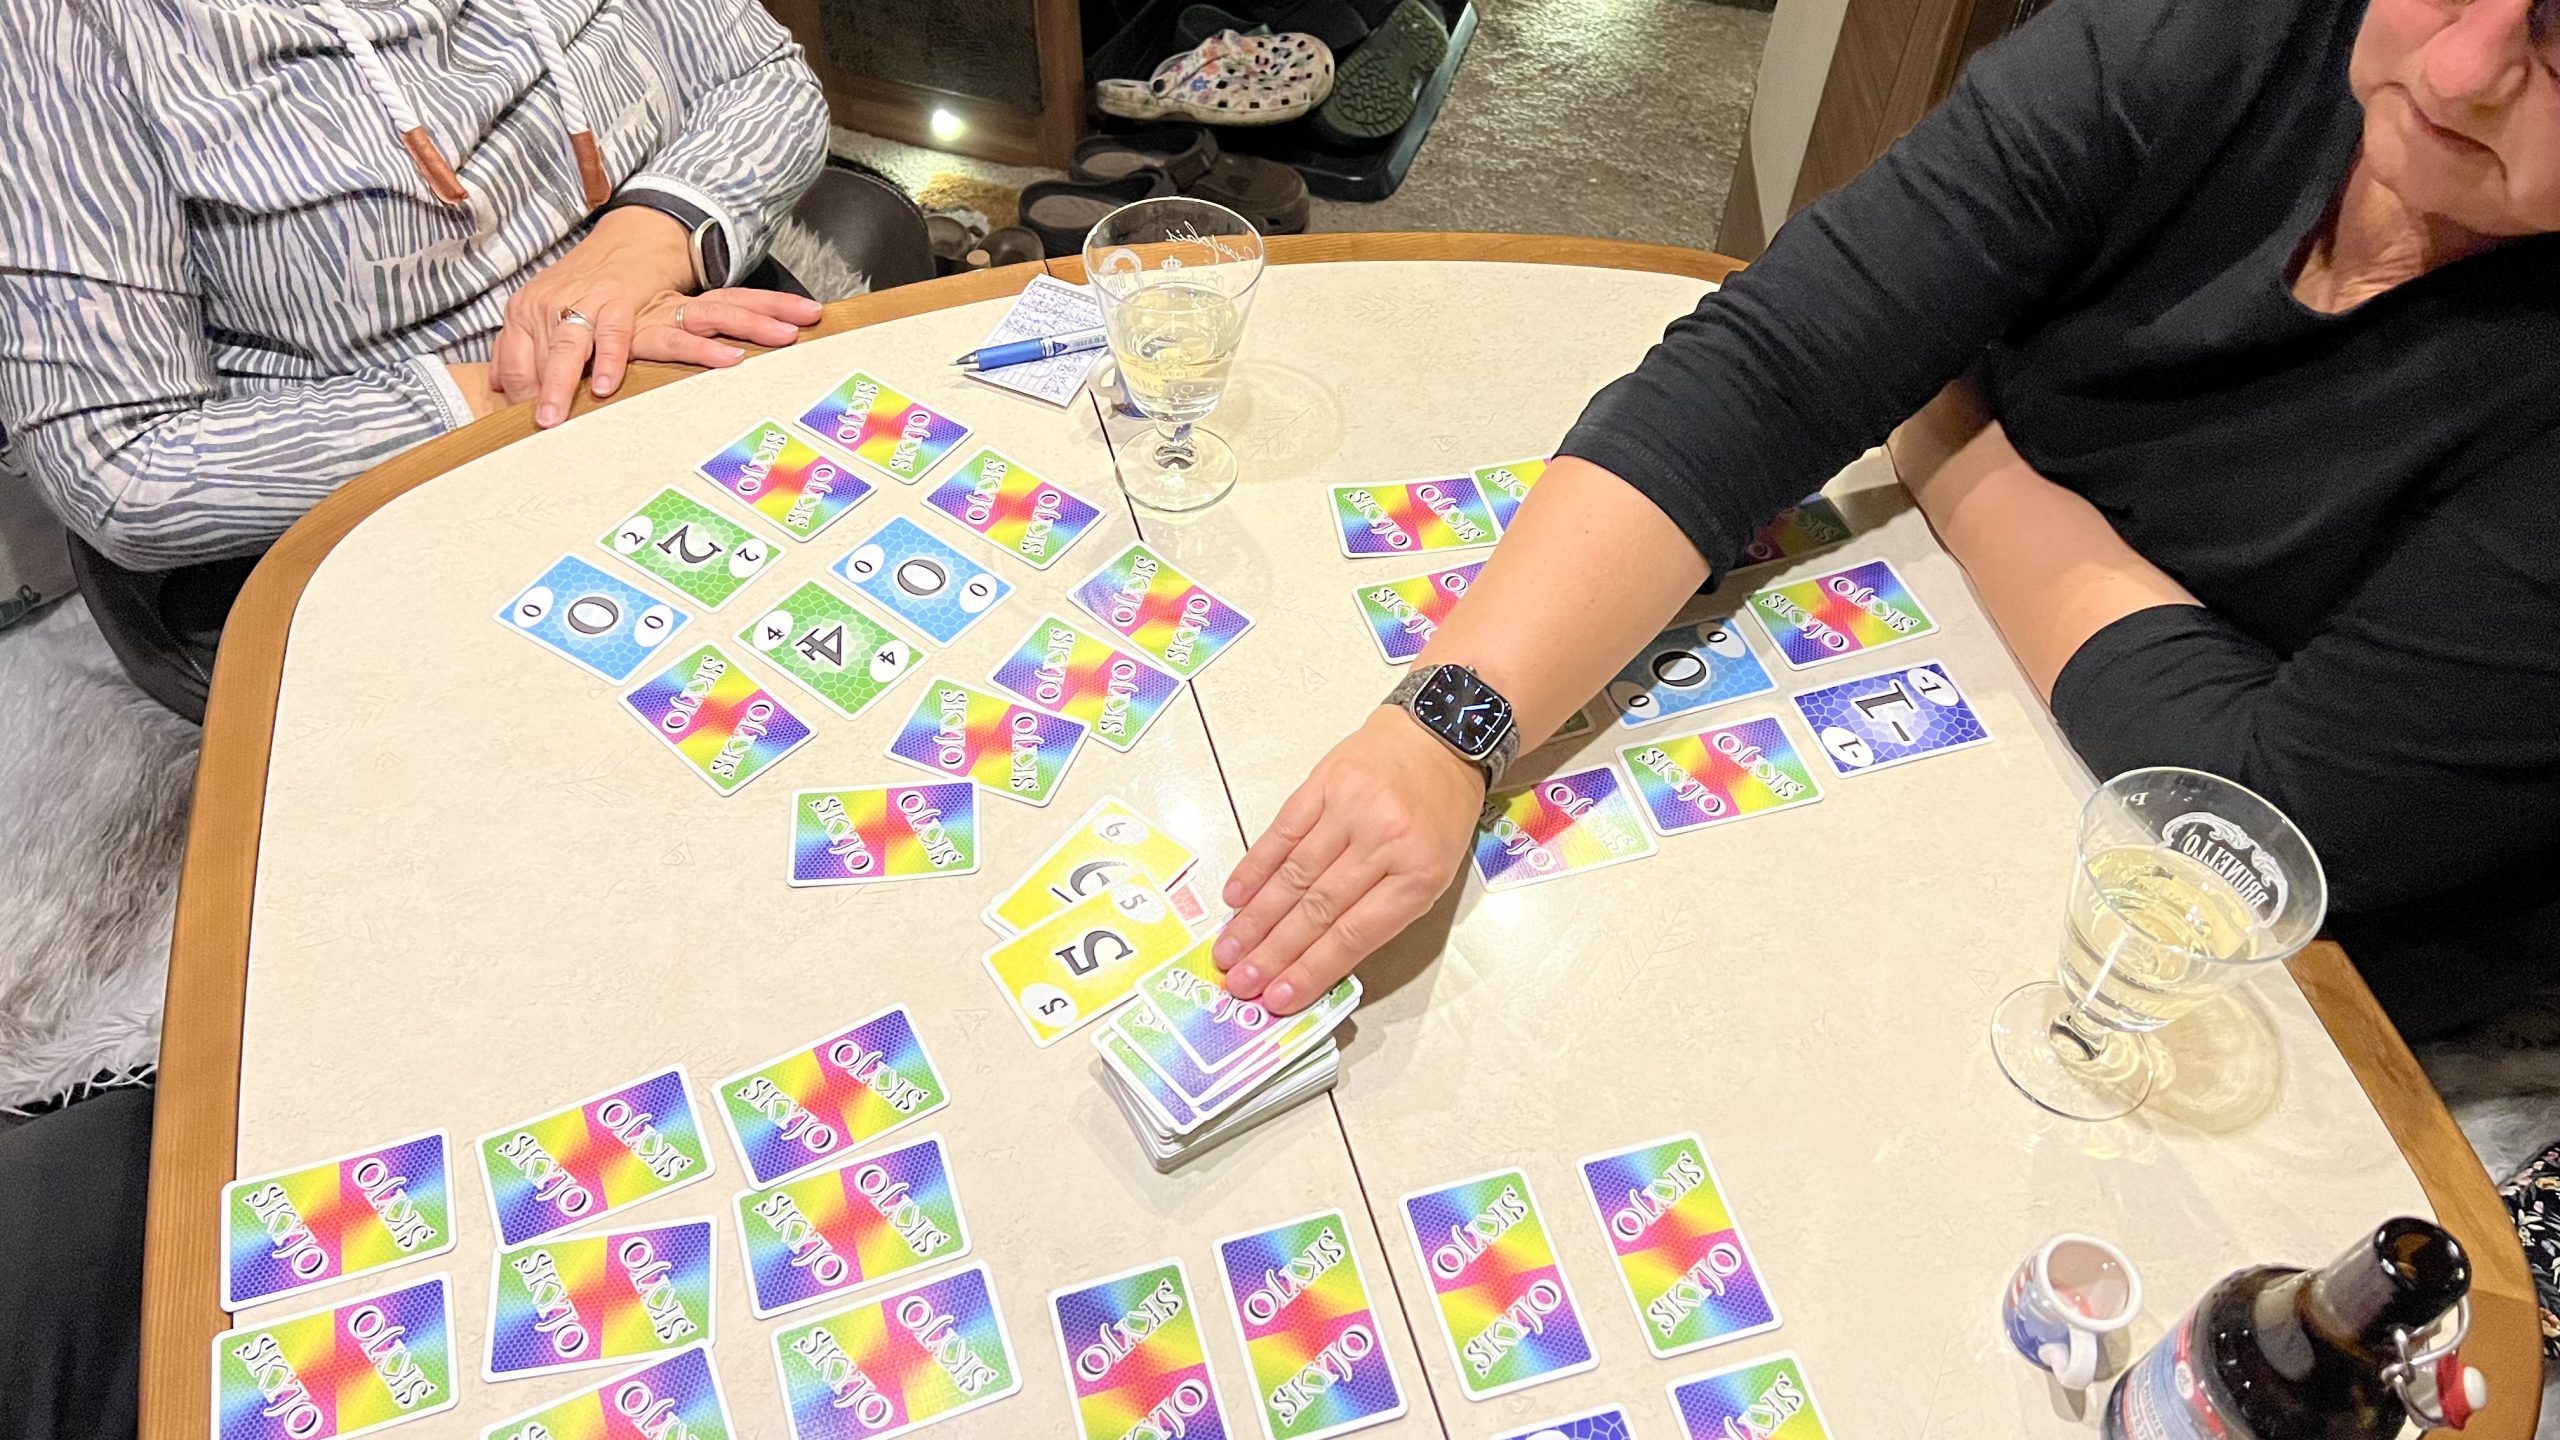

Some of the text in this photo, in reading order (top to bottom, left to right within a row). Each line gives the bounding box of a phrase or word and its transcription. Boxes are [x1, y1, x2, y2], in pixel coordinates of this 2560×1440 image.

[837, 381, 878, 443] SKYJO
[889, 410, 931, 472] SKYJO
[737, 431, 786, 495] SKYJO
[786, 464, 836, 528] SKYJO
[966, 456, 1008, 526] SKYJO
[621, 531, 645, 545] 2
[657, 525, 722, 564] 2
[1020, 491, 1062, 556] SKYJO
[1345, 488, 1411, 551] SKYJO
[1415, 484, 1482, 543] SKYJO
[736, 548, 760, 563] 2
[854, 560, 872, 574] 0
[897, 559, 945, 596] 0
[970, 583, 988, 597] 0
[523, 604, 541, 617] 0
[568, 597, 619, 634] 0
[646, 615, 664, 629] 0
[1115, 555, 1157, 628] SKYJO
[1761, 591, 1849, 652] SKYJO
[1829, 576, 1920, 633] SKYJO
[767, 625, 786, 641] 4
[796, 625, 842, 666] 4
[878, 650, 898, 666] 4
[1165, 594, 1211, 666] SKYJO
[1707, 630, 1727, 643] 0
[663, 655, 725, 734] SKYJO
[1036, 627, 1076, 704] SKYJO
[1100, 659, 1136, 736] SKYJO
[1653, 651, 1706, 688] 0
[1920, 676, 1942, 695] -1
[933, 690, 967, 769] SKYJO
[1628, 694, 1649, 709] 0
[1855, 683, 1914, 742] -1
[709, 699, 773, 779] SKYJO
[1011, 712, 1044, 791] SKYJO
[1712, 731, 1804, 801] SKYJO
[1839, 738, 1861, 758] -1
[1637, 747, 1727, 817] SKYJO
[808, 796, 875, 875] SKYJO
[897, 789, 963, 867] SKYJO
[1100, 822, 1126, 842] 6
[1120, 894, 1147, 910] 5
[1055, 930, 1134, 976] 5
[1038, 997, 1069, 1016] 5
[1157, 968, 1268, 1030] SKYJO
[828, 1040, 929, 1113] SKYJO
[597, 1099, 693, 1181] SKYJO
[736, 1077, 838, 1153] SKYJO
[352, 1158, 436, 1250] SKYJO
[499, 1131, 593, 1216] SKYJO
[1611, 1152, 1704, 1243] SKYJO
[243, 1183, 329, 1279] SKYJO
[754, 1191, 848, 1286] SKYJO
[854, 1165, 950, 1256] SKYJO
[1432, 1186, 1529, 1279] SKYJO
[515, 1250, 589, 1357] SKYJO
[618, 1236, 698, 1343] SKYJO
[1243, 1226, 1346, 1326] SKYJO
[1647, 1242, 1743, 1338] SKYJO
[348, 1305, 438, 1408] SKYJO
[896, 1296, 999, 1393] SKYJO
[1076, 1278, 1183, 1381] SKYJO
[1462, 1278, 1562, 1379] SKYJO
[232, 1334, 323, 1438] SKYJO
[794, 1326, 894, 1428] SKYJO
[1269, 1323, 1374, 1428] SKYJO
[1718, 1371, 1804, 1440] SKYJ
